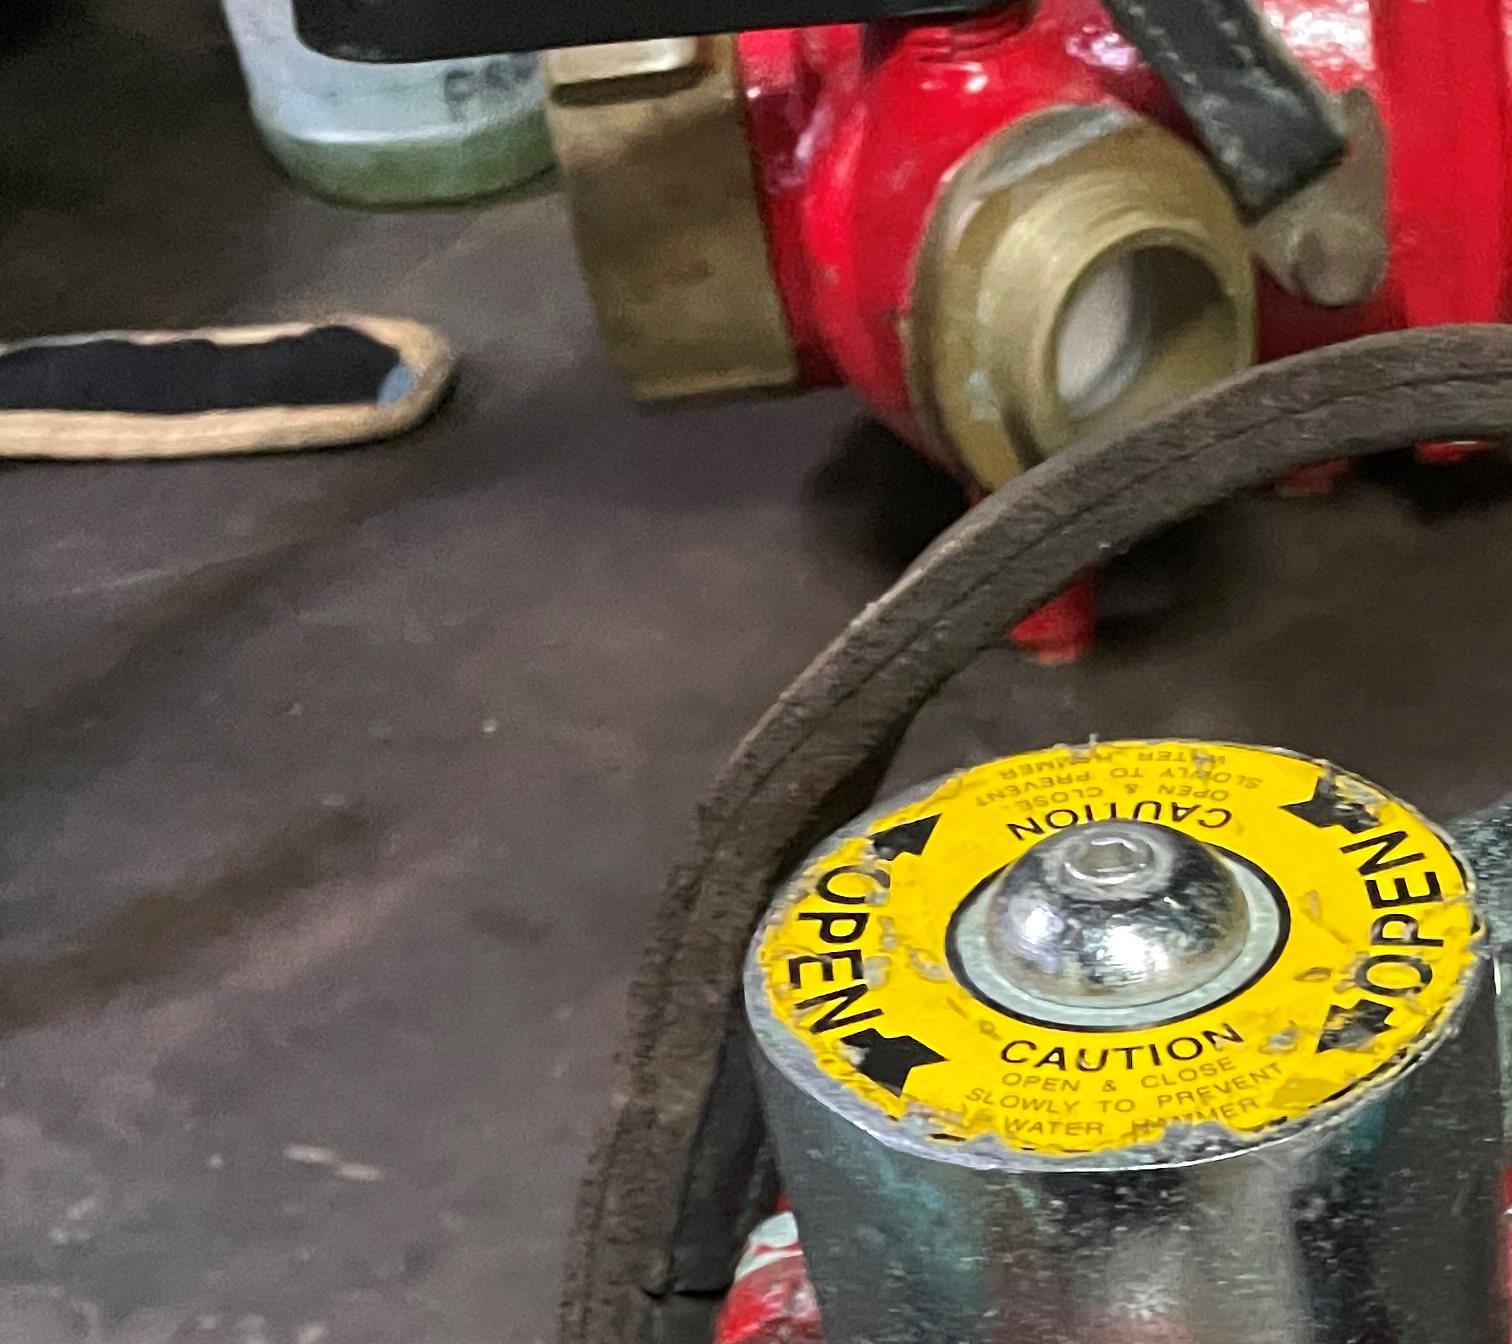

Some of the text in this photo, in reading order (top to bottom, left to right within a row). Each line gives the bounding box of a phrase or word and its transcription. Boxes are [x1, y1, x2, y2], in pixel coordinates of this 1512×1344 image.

[1015, 783, 1230, 811] OPEN & CLOSE
[1006, 800, 1232, 841] CAUTION
[1340, 830, 1445, 997] OPEN
[788, 865, 890, 1035] OPEN
[1000, 1022, 1244, 1072] CAUTION
[965, 1061, 1284, 1114] SLOWLY TO PREVENT
[1001, 1056, 1237, 1093] OPEN & CLOSE
[1003, 1115, 1104, 1136] WATER
